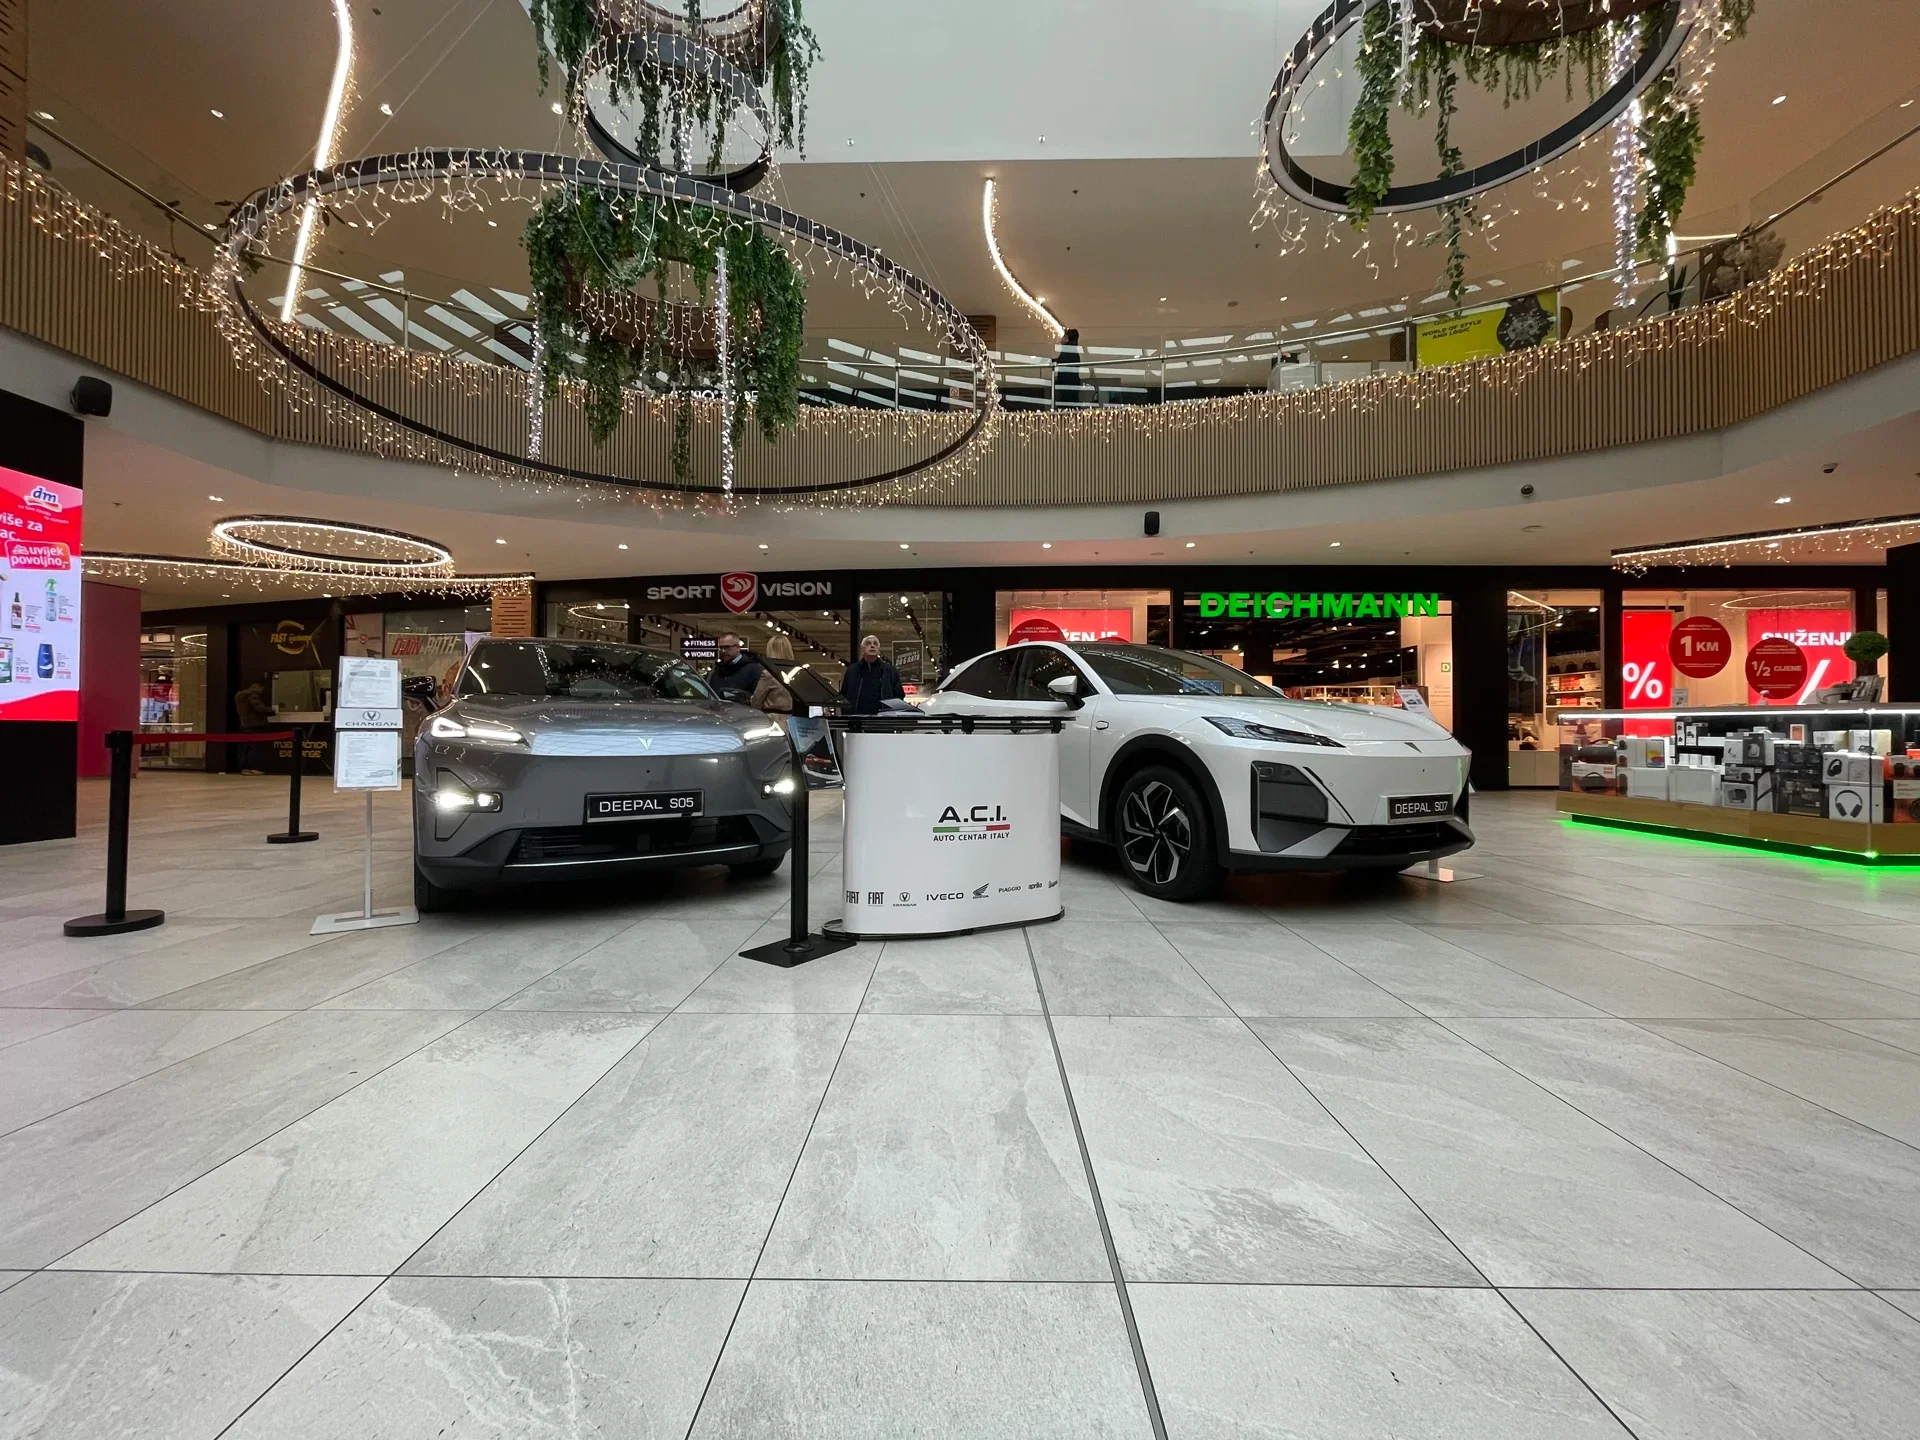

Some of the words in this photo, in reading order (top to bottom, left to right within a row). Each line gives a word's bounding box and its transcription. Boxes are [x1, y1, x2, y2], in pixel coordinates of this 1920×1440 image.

[1421, 327, 1447, 337] WORLD
[1460, 319, 1482, 329] STYLE
[1448, 327, 1471, 336] LOGIC
[33, 487, 57, 503] dm
[27, 520, 43, 532] za
[29, 546, 64, 558] uvijek
[647, 585, 716, 600] SPORT
[761, 581, 832, 597] VISION
[1200, 592, 1439, 618] DEICHMANN
[424, 635, 459, 656] PATH
[1680, 635, 1692, 657] 1
[1696, 641, 1719, 652] KM
[599, 799, 663, 812] DEEPAL
[669, 797, 694, 809] S05
[1395, 802, 1431, 814] DEEPAL
[1434, 801, 1449, 812] S07
[938, 805, 1007, 823] A.C.I.
[933, 834, 955, 842] AUTO
[958, 833, 987, 841] CENTAR
[990, 832, 1010, 840] ITALY
[845, 890, 860, 904] FIAT
[868, 891, 884, 905] FIAT
[926, 892, 964, 901] IVECO
[998, 885, 1022, 893] PIAGGIO
